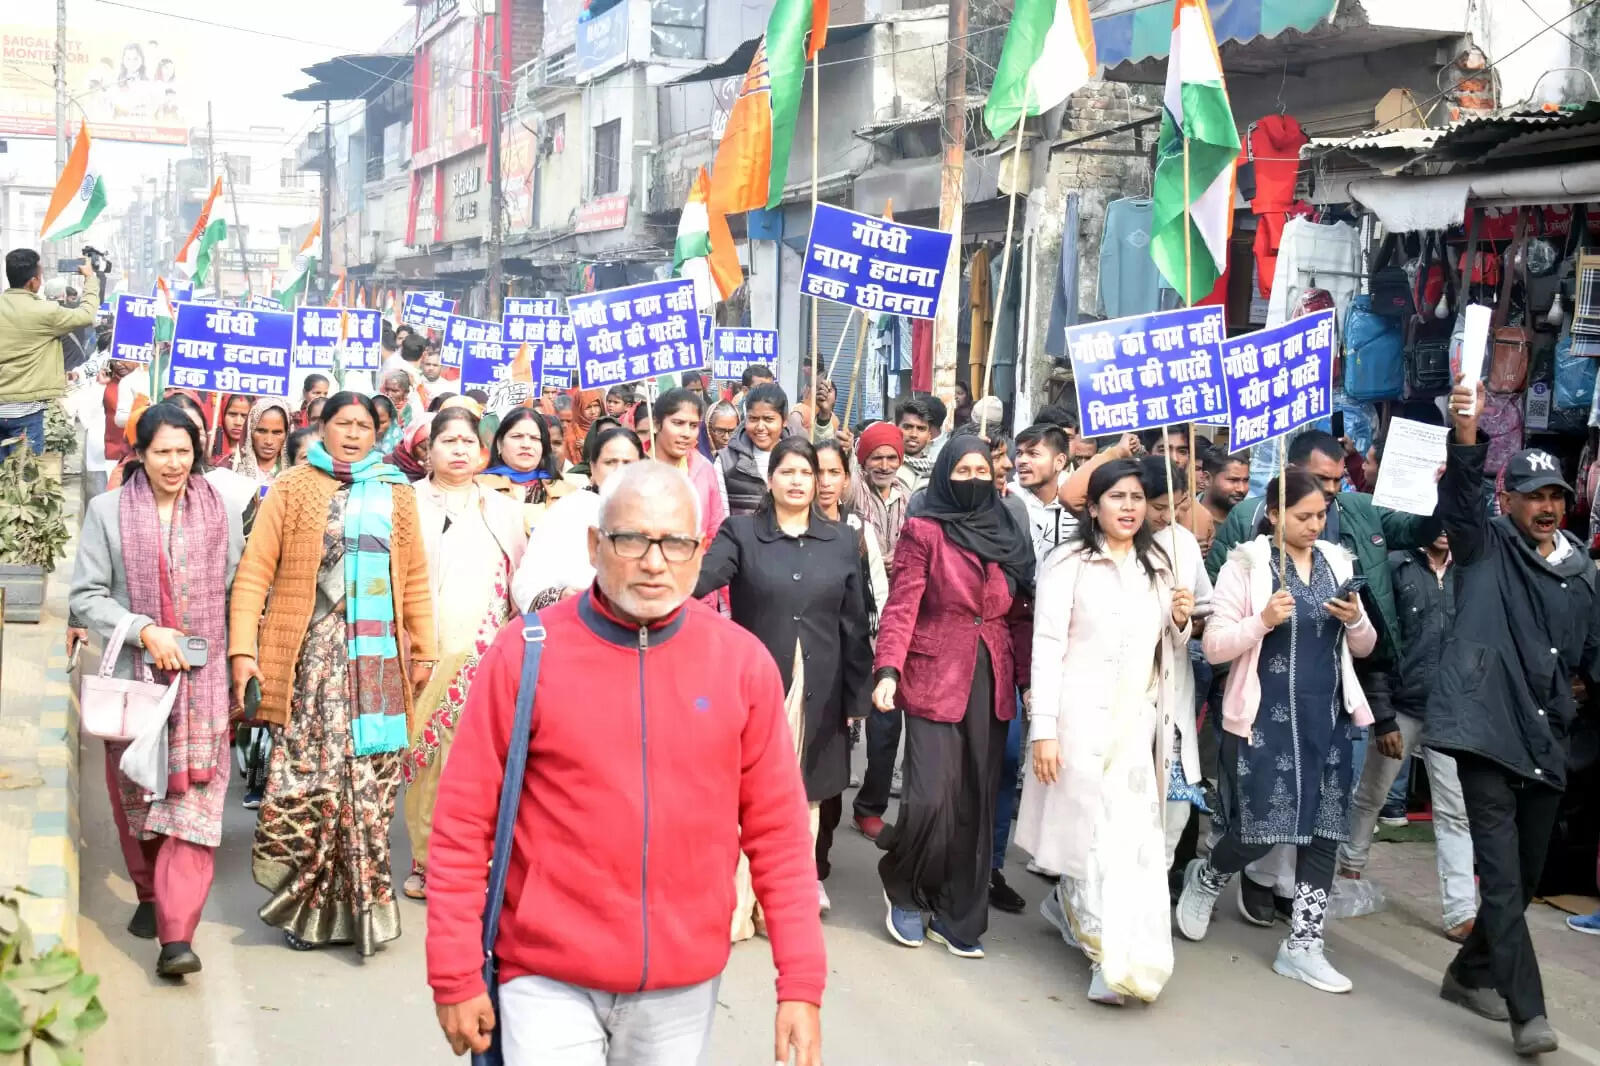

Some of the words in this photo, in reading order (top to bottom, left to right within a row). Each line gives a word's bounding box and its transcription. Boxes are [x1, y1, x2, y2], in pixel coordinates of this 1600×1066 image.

[3, 34, 50, 49] SAIGAL
[813, 243, 862, 275] नाम
[869, 258, 940, 288] हटाना
[610, 300, 632, 322] का
[632, 294, 662, 317] नाम
[664, 284, 694, 312] नहीं
[808, 273, 849, 300] हक
[856, 283, 934, 316] छीनना
[176, 338, 217, 360] नाम
[222, 343, 288, 368] हटाना
[586, 328, 623, 355] गरीब
[624, 321, 646, 348] की
[648, 314, 688, 343] गारंटी
[1118, 332, 1146, 357] का
[1149, 324, 1185, 352] नाम
[1187, 314, 1222, 347] नहीं
[1261, 342, 1282, 369] का
[1282, 332, 1304, 364] नाम
[1305, 316, 1333, 353] नहीं
[173, 365, 209, 387] हक
[214, 366, 286, 395] छीनना
[585, 353, 627, 385] मिटाई
[628, 354, 650, 375] जा
[651, 345, 675, 371] रही
[1090, 362, 1136, 396] गरीब
[1136, 356, 1165, 388] की
[1167, 350, 1213, 384] गारंटी
[1237, 376, 1270, 411] गरीब
[1272, 368, 1291, 400] की
[1291, 356, 1321, 392] गारंटी
[1087, 392, 1140, 430] मिटाई
[1142, 394, 1170, 421] जा
[1171, 384, 1198, 415] रही
[1234, 404, 1270, 447] मिटाई
[1272, 400, 1291, 429] जा
[1291, 390, 1310, 422] रही
